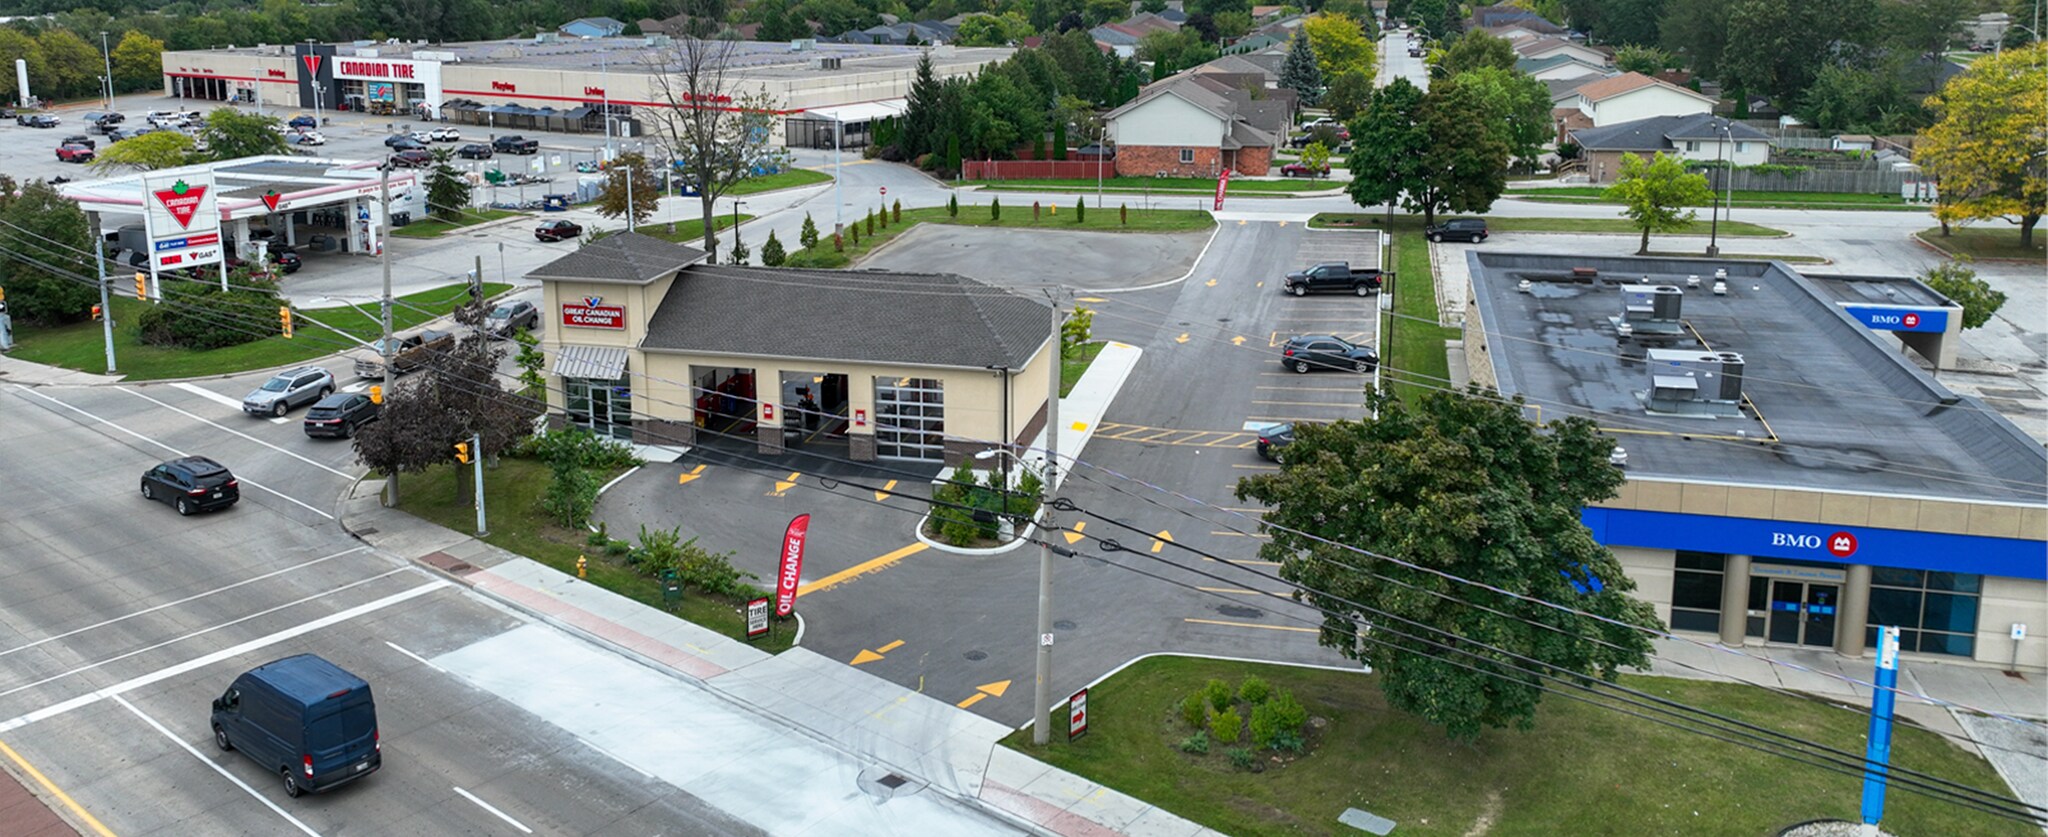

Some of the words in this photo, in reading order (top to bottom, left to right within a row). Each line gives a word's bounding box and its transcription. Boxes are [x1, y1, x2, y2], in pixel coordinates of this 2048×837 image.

[340, 61, 389, 78] CANADIAN
[391, 63, 415, 79] TIRE
[492, 80, 516, 93] Playing
[166, 196, 199, 208] CANADIAN
[176, 205, 191, 214] TIRE
[585, 309, 620, 317] CANADIAN
[584, 316, 612, 324] CHANGE
[1872, 315, 1900, 324] BMO
[1771, 532, 1822, 549] BMO
[783, 538, 800, 589] CHANGE
[779, 592, 792, 613] OIL
[749, 606, 766, 616] TIRE
